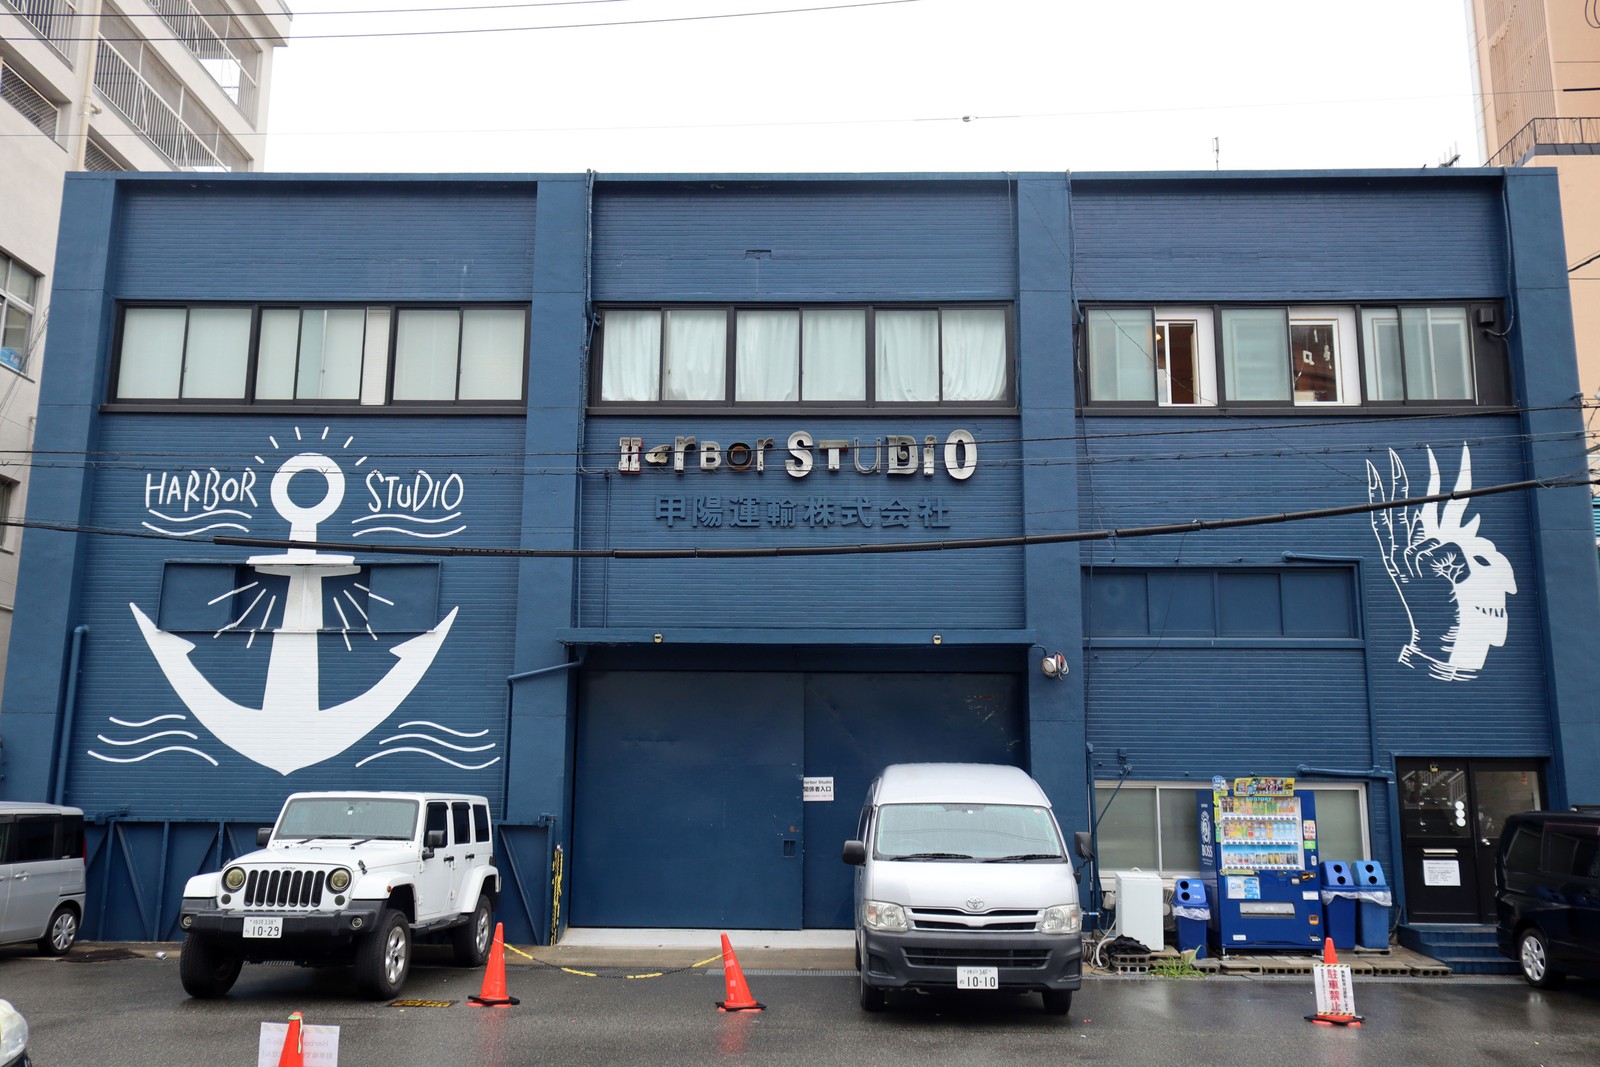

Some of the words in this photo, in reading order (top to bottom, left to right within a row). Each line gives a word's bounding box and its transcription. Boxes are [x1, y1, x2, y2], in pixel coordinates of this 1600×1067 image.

[145, 467, 258, 511] HARBOR
[365, 470, 464, 511] STUDIO
[655, 496, 951, 529] 甲陽運輸株式会社
[1201, 843, 1214, 858] BOSS
[967, 976, 996, 987] 10-10
[1327, 969, 1341, 1011] 駐車禁止
